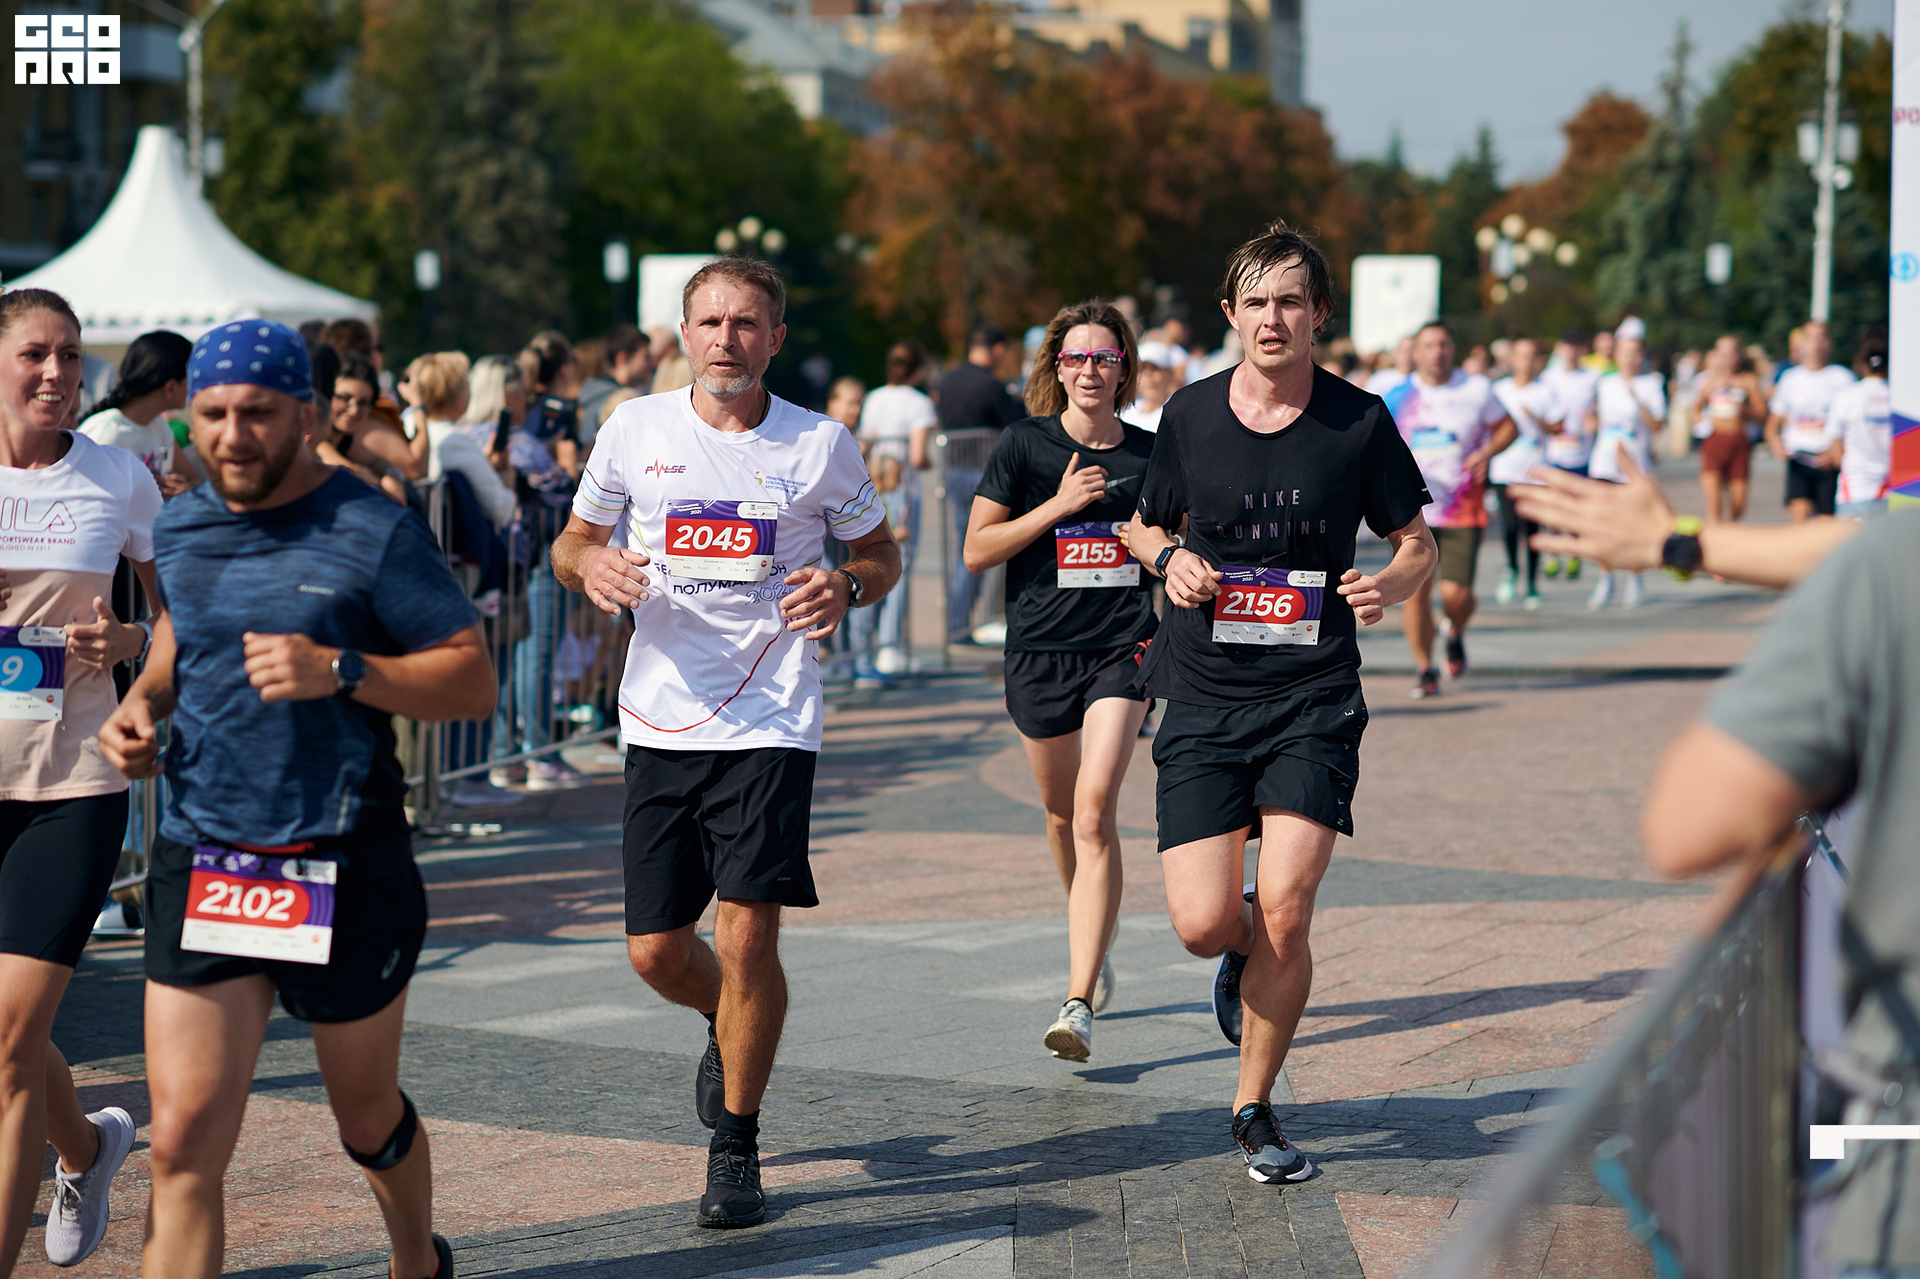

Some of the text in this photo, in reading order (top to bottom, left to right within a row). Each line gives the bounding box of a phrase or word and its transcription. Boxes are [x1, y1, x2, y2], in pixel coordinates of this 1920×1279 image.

[1244, 489, 1300, 509] NIKE
[0, 496, 77, 535] ILA
[47, 537, 76, 545] BRAND
[672, 525, 753, 552] 2045
[1216, 519, 1326, 540] RUNNING
[1063, 542, 1118, 565] 2155
[1222, 591, 1294, 618] 2156
[196, 880, 296, 922] 2102
